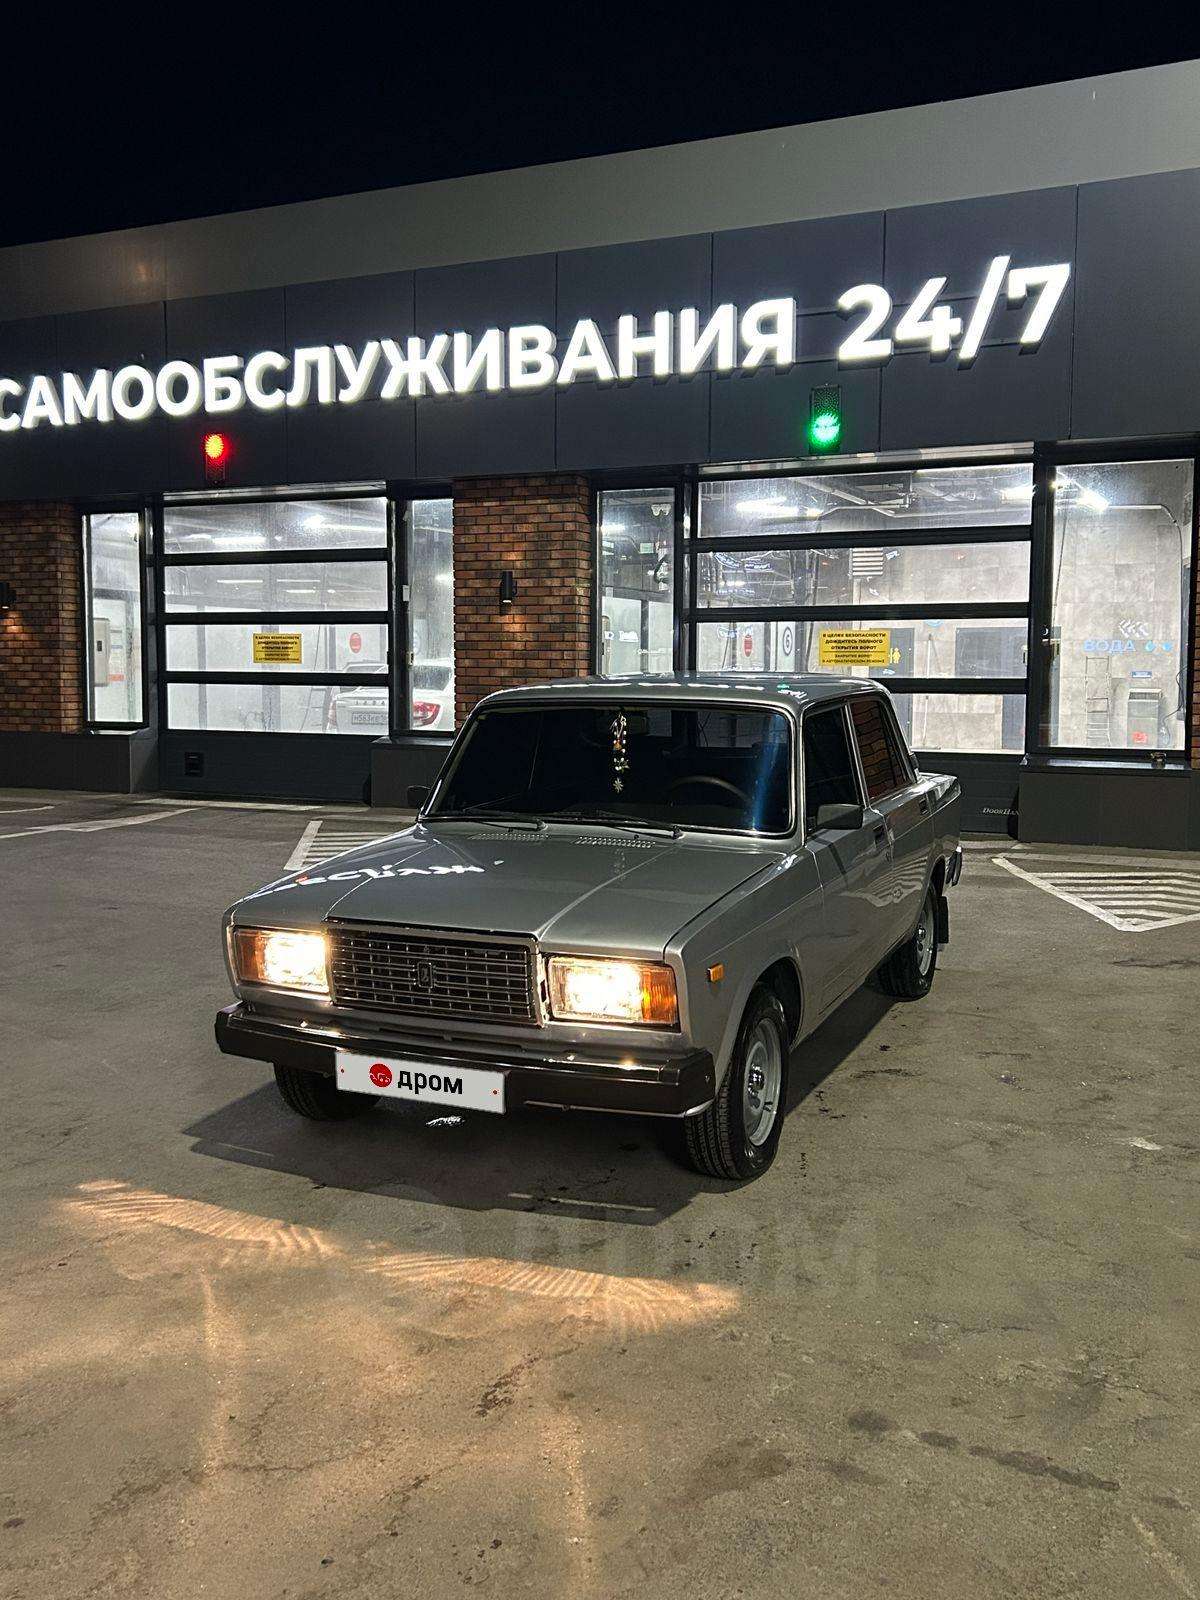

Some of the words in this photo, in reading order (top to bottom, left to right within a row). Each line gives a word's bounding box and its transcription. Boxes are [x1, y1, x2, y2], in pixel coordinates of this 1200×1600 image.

[0, 297, 797, 432] САМООБСЛУЖИВАНИЯ
[838, 255, 1071, 364] 24/7
[1083, 640, 1136, 655] ВОДА
